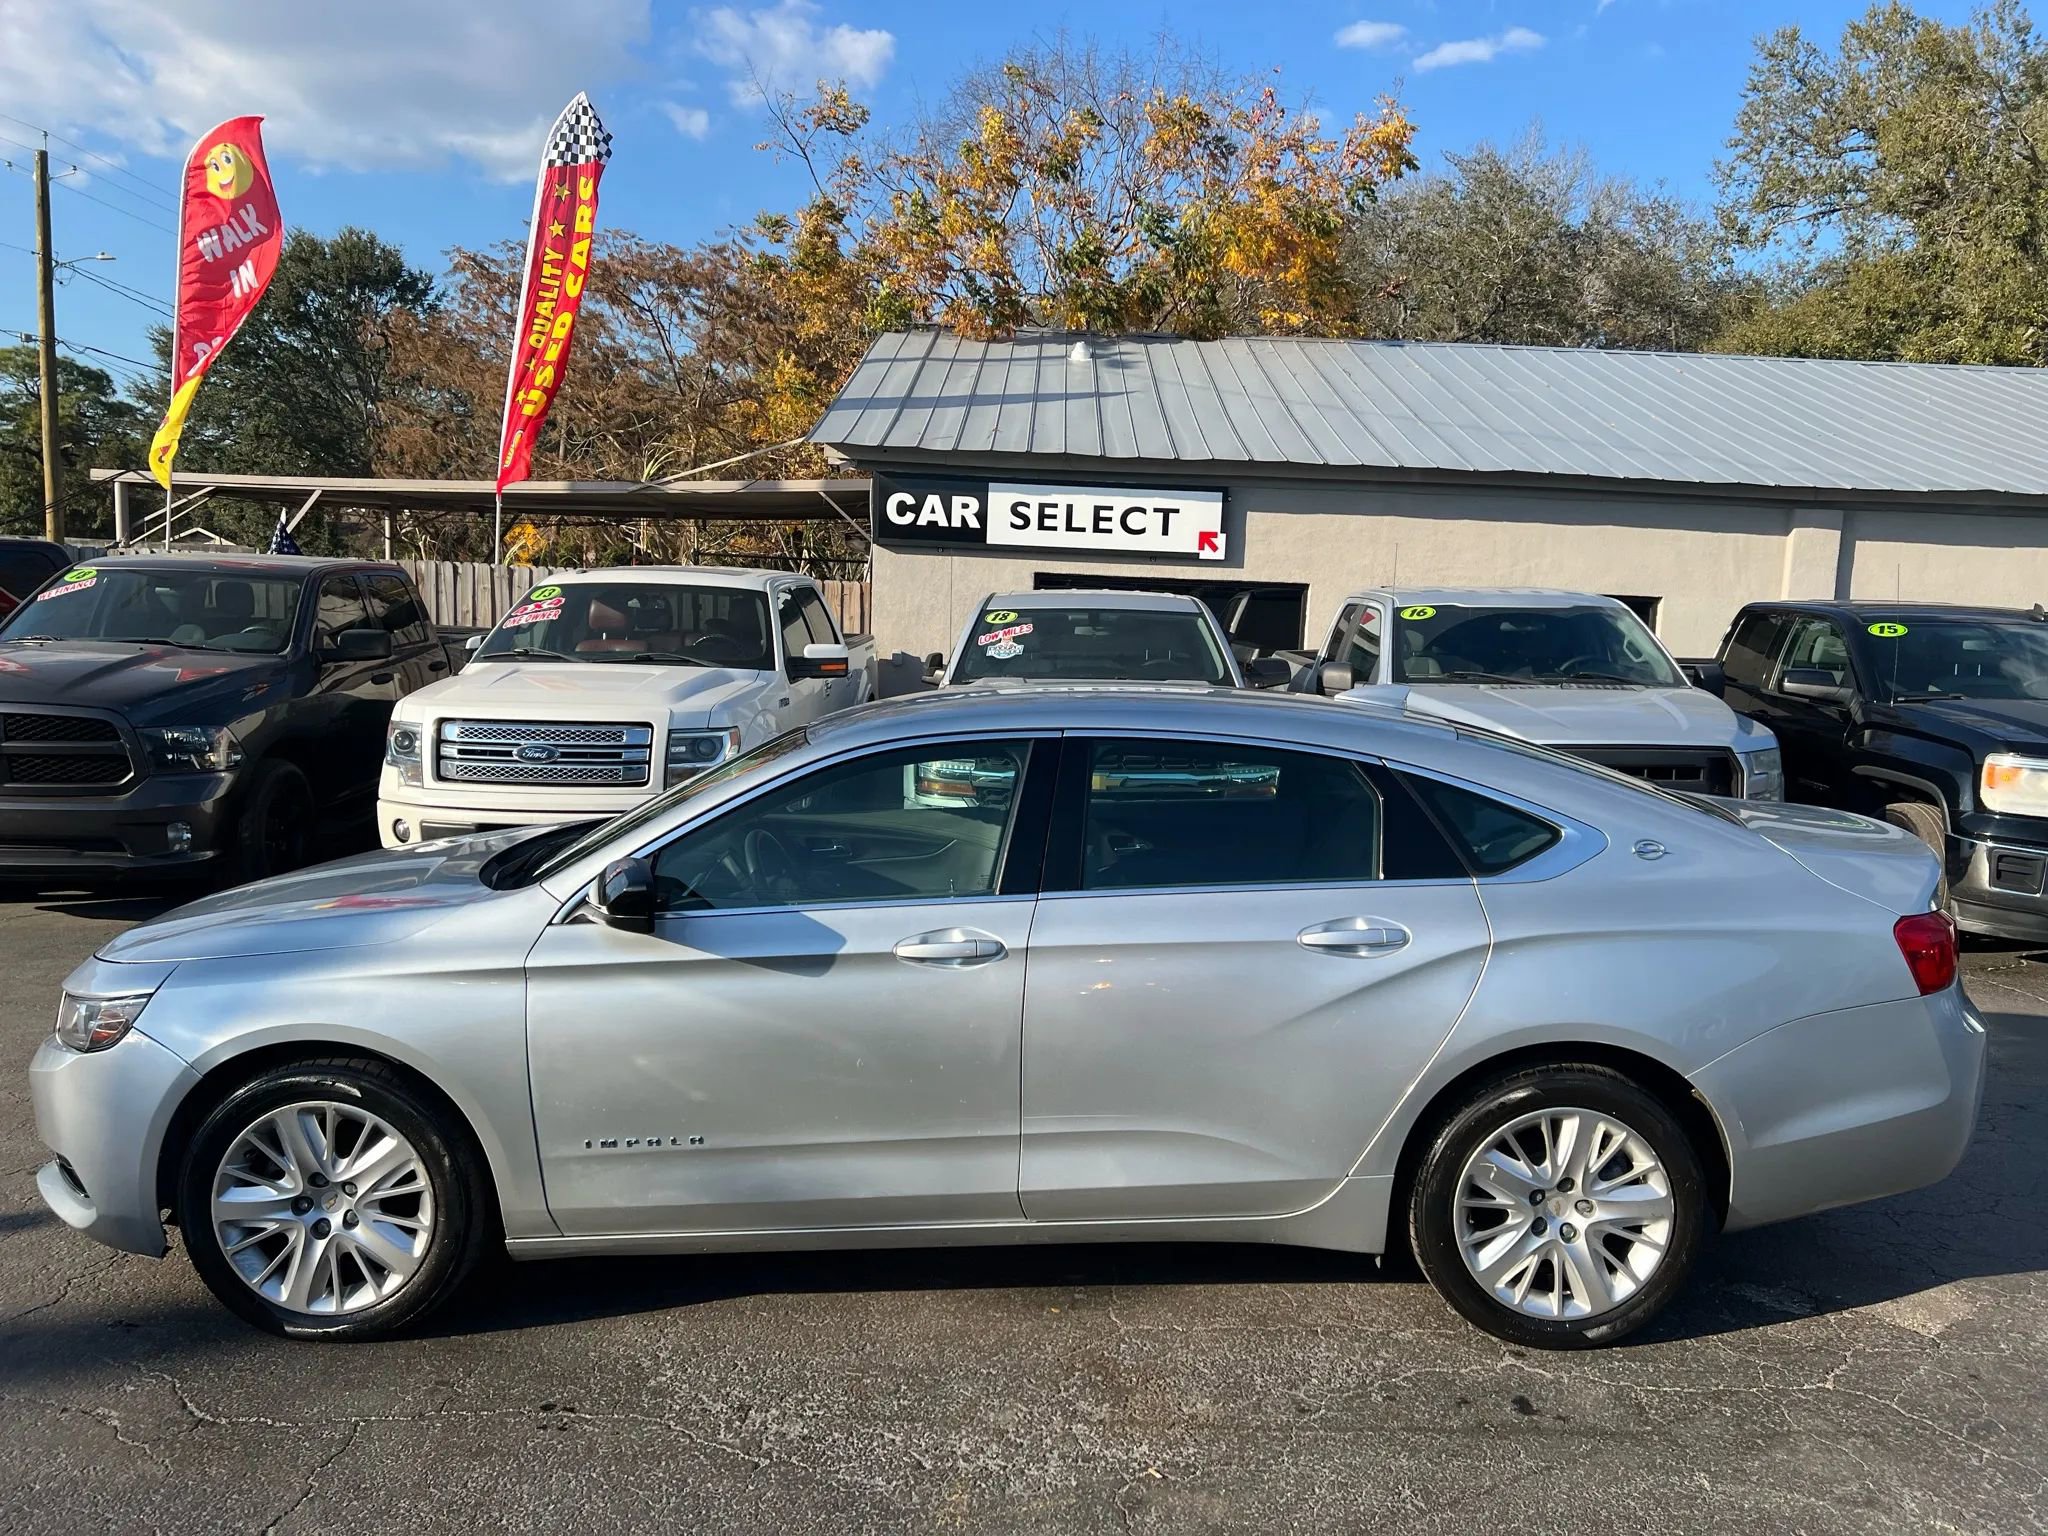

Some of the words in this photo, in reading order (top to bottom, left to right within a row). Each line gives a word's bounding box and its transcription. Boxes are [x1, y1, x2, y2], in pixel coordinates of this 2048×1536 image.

[198, 204, 268, 263] WALK
[230, 260, 259, 299] IN
[528, 247, 564, 349] QUALITY
[521, 311, 574, 416] USED
[886, 492, 981, 529] CAR
[1009, 501, 1180, 536] SELECT
[54, 580, 96, 597] FINANCE
[535, 588, 556, 599] 13
[504, 616, 523, 628] ONE
[525, 609, 560, 623] OWNER
[990, 612, 1011, 622] 18
[1409, 608, 1428, 618] 16
[979, 632, 1000, 645] LOW
[1002, 624, 1032, 637] MILES
[1878, 625, 1898, 635] 15
[584, 1135, 705, 1149] IMPALA
